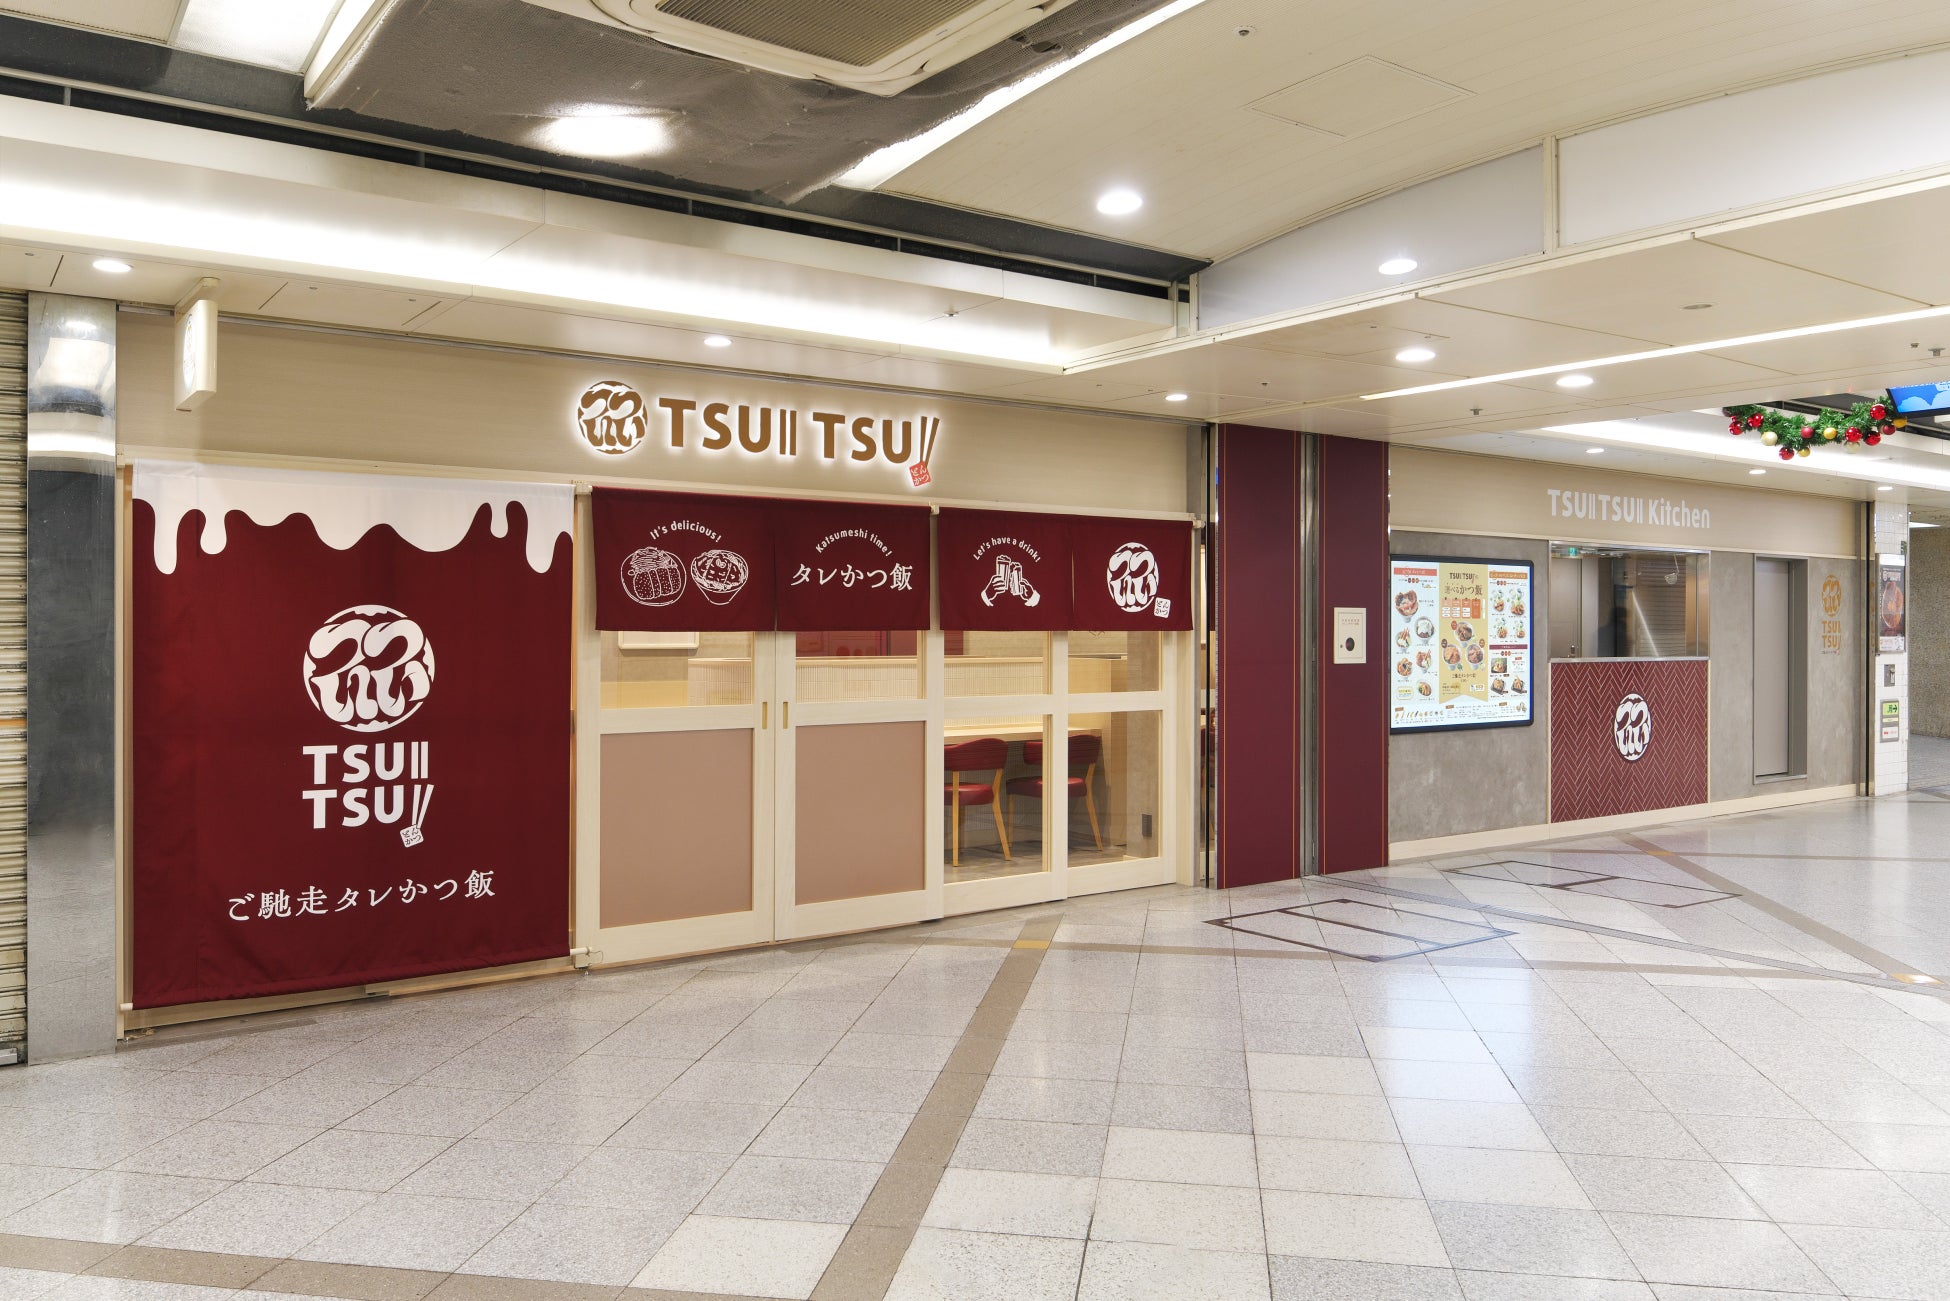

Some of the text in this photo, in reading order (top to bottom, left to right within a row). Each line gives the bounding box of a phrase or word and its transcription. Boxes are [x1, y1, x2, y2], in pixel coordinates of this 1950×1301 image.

[1648, 498, 1711, 529] Kitchen
[649, 519, 722, 543] It's delicious!
[815, 528, 893, 557] Katsumeshi time!
[973, 537, 1041, 563] Let's have a drink!
[790, 562, 914, 592] タレかつ飯
[227, 869, 496, 922] ご馳走タレかつ飯
